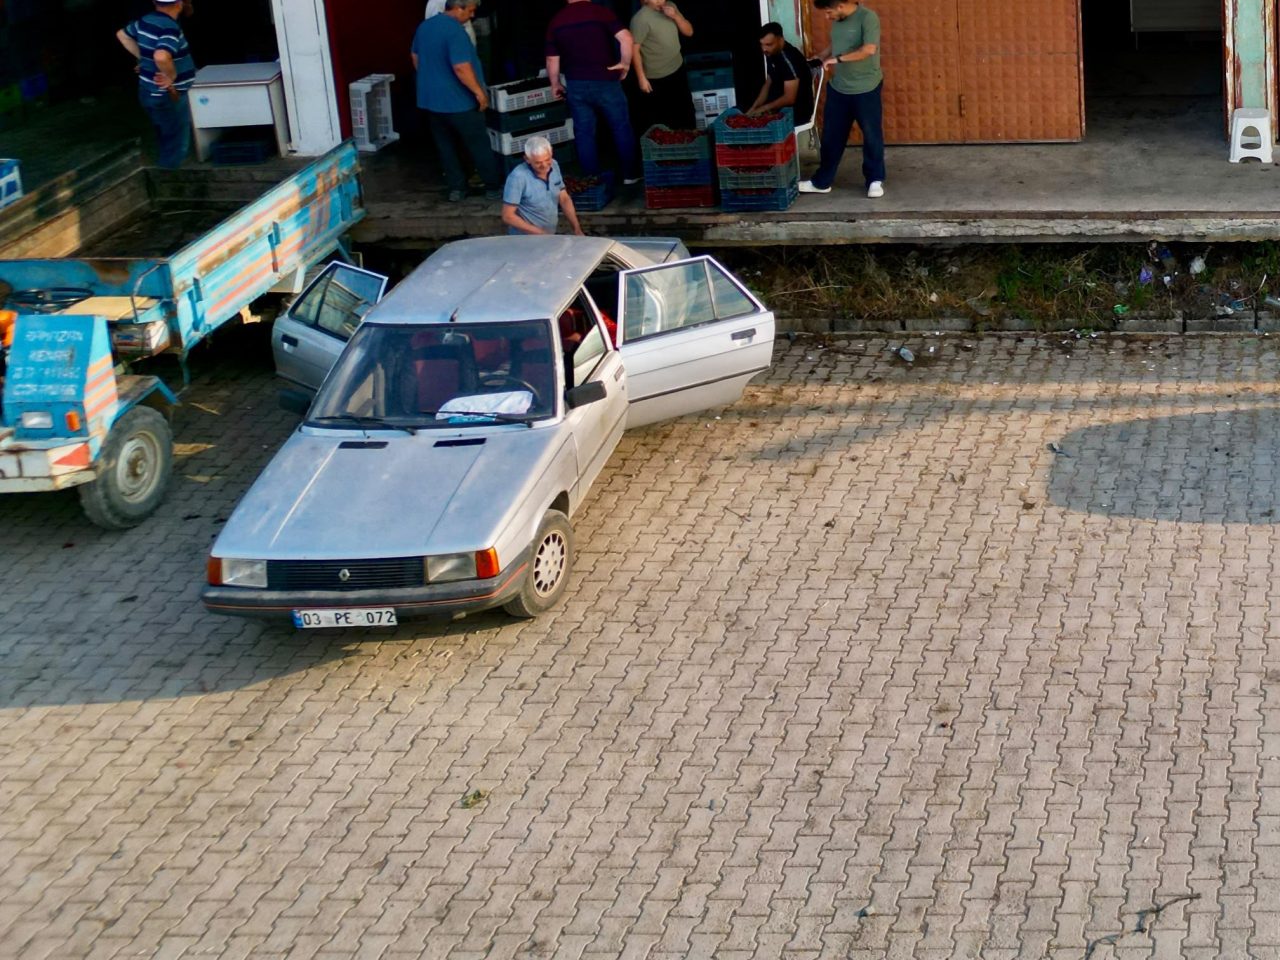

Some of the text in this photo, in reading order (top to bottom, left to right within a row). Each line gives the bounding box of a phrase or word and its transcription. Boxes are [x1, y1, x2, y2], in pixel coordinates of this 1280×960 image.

[303, 611, 395, 625] 03 PE 072
